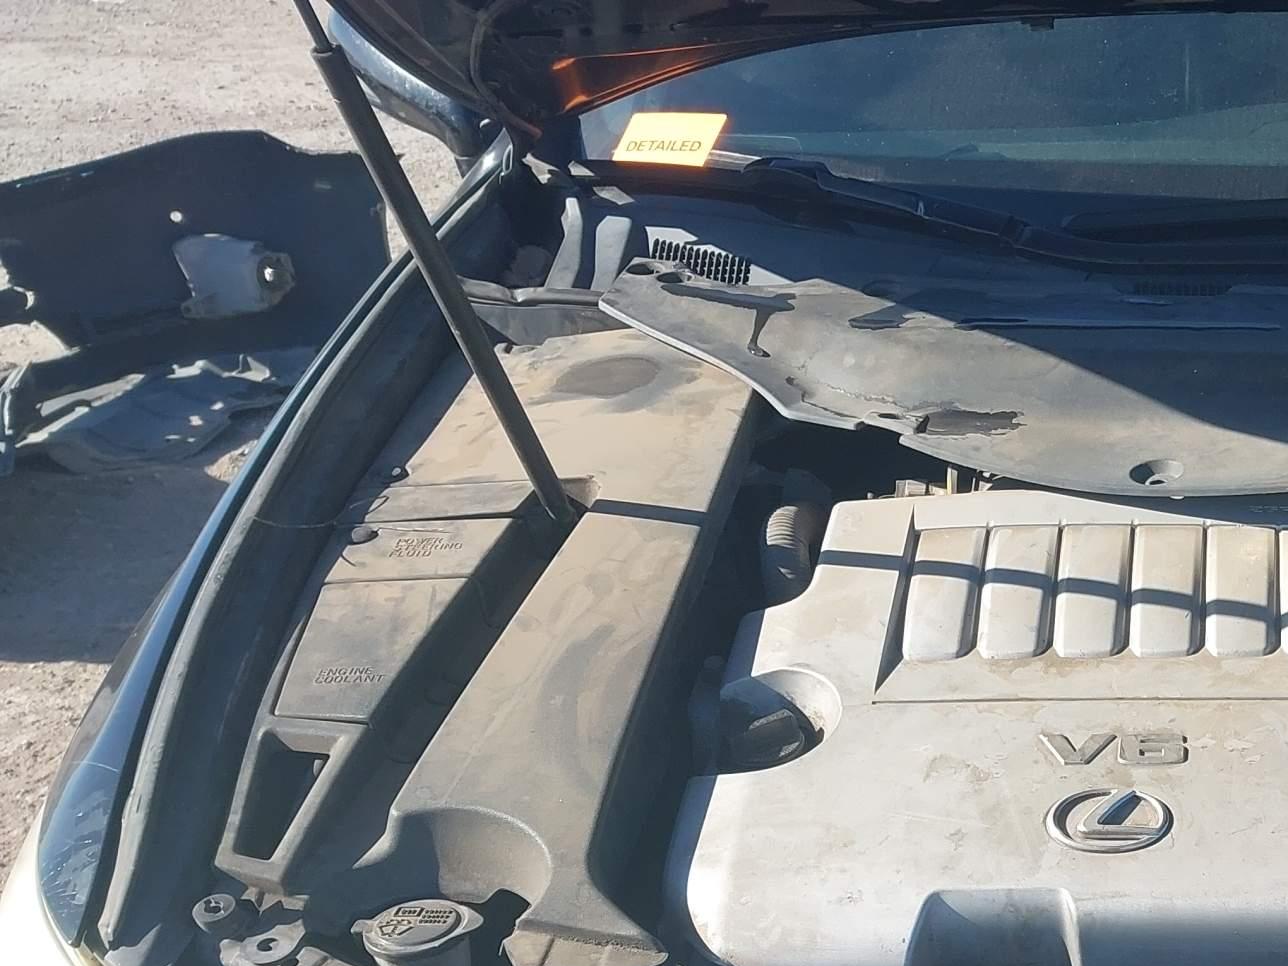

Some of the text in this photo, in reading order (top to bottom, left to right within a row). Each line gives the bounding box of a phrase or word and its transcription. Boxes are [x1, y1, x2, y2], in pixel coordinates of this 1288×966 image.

[625, 140, 702, 152] DETAILED
[396, 538, 444, 546] POWER
[388, 550, 432, 558] FLUID
[318, 666, 375, 676] ENGINE
[314, 674, 385, 684] COOLANT
[1038, 731, 1190, 766] V6
